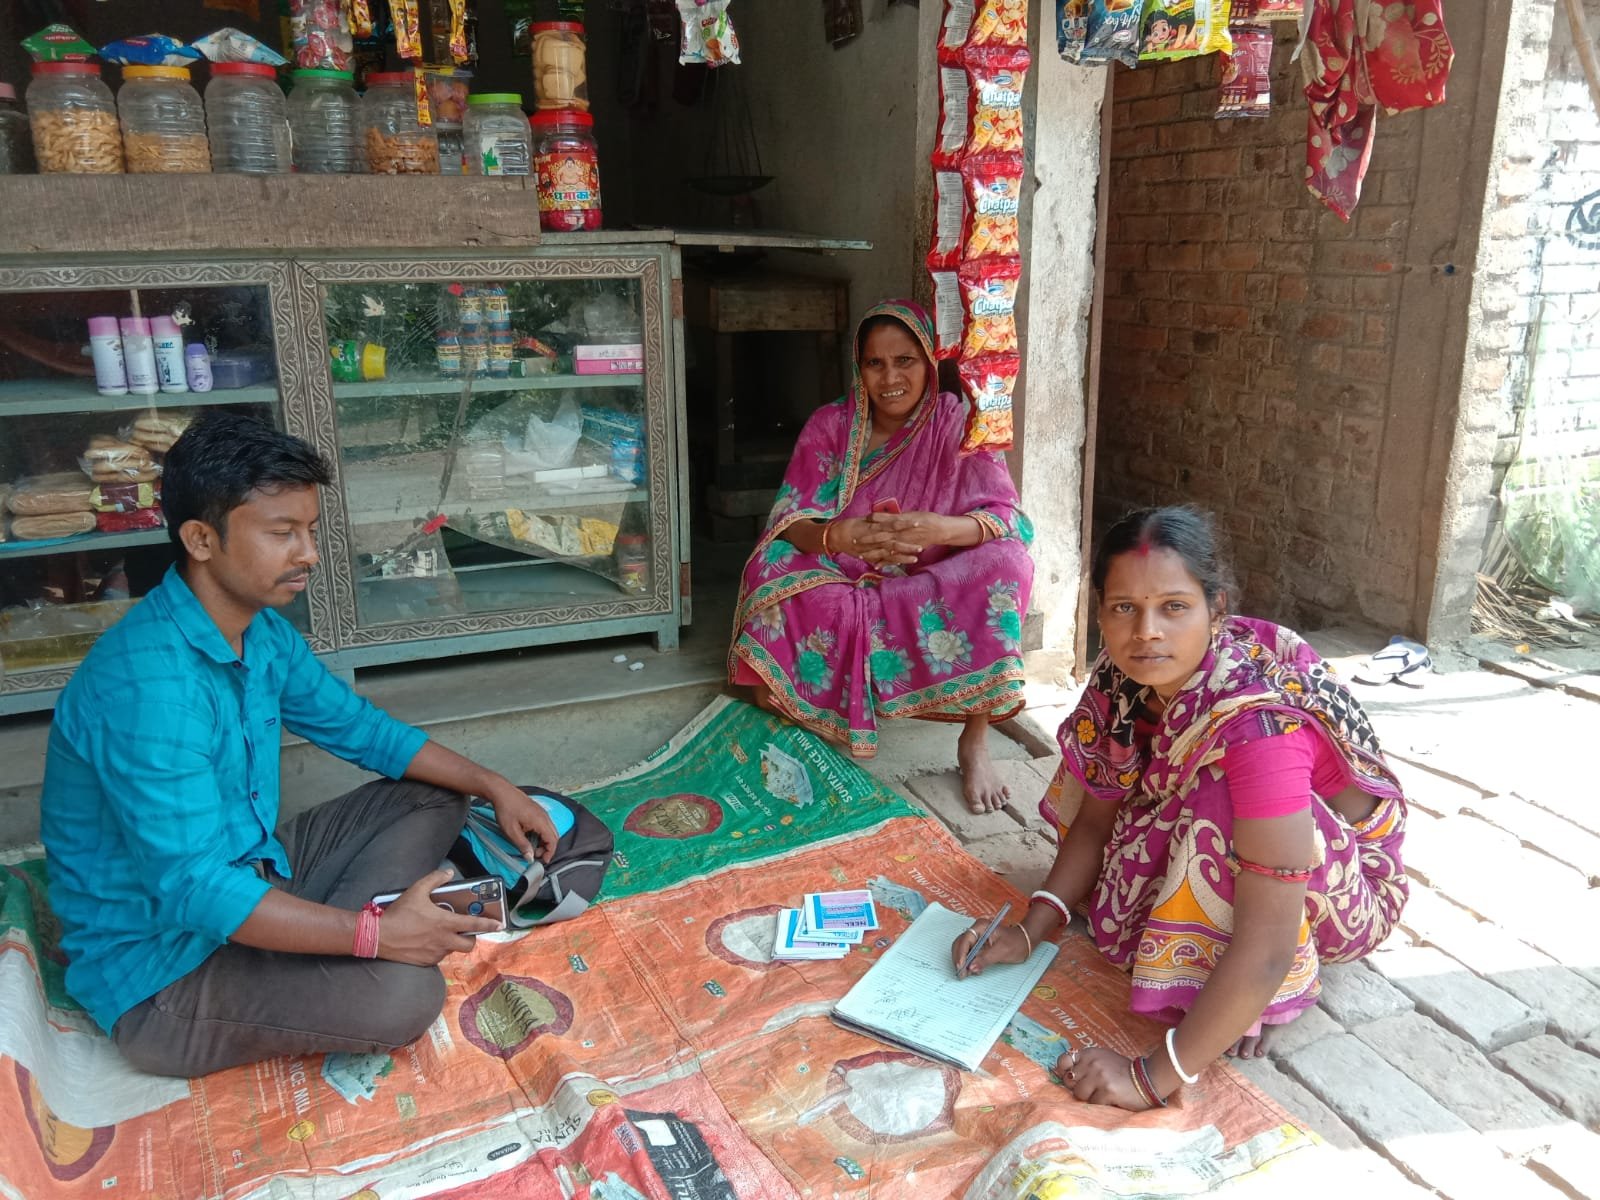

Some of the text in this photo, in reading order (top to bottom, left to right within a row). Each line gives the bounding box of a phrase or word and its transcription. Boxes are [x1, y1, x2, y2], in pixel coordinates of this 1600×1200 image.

[553, 190, 590, 202] धमाका
[793, 728, 813, 751] MILL
[808, 749, 829, 772] RICE
[827, 771, 853, 803] SUNITA
[908, 866, 930, 886] MILL
[1050, 1006, 1079, 1029] MILL
[293, 1087, 311, 1115] MILL
